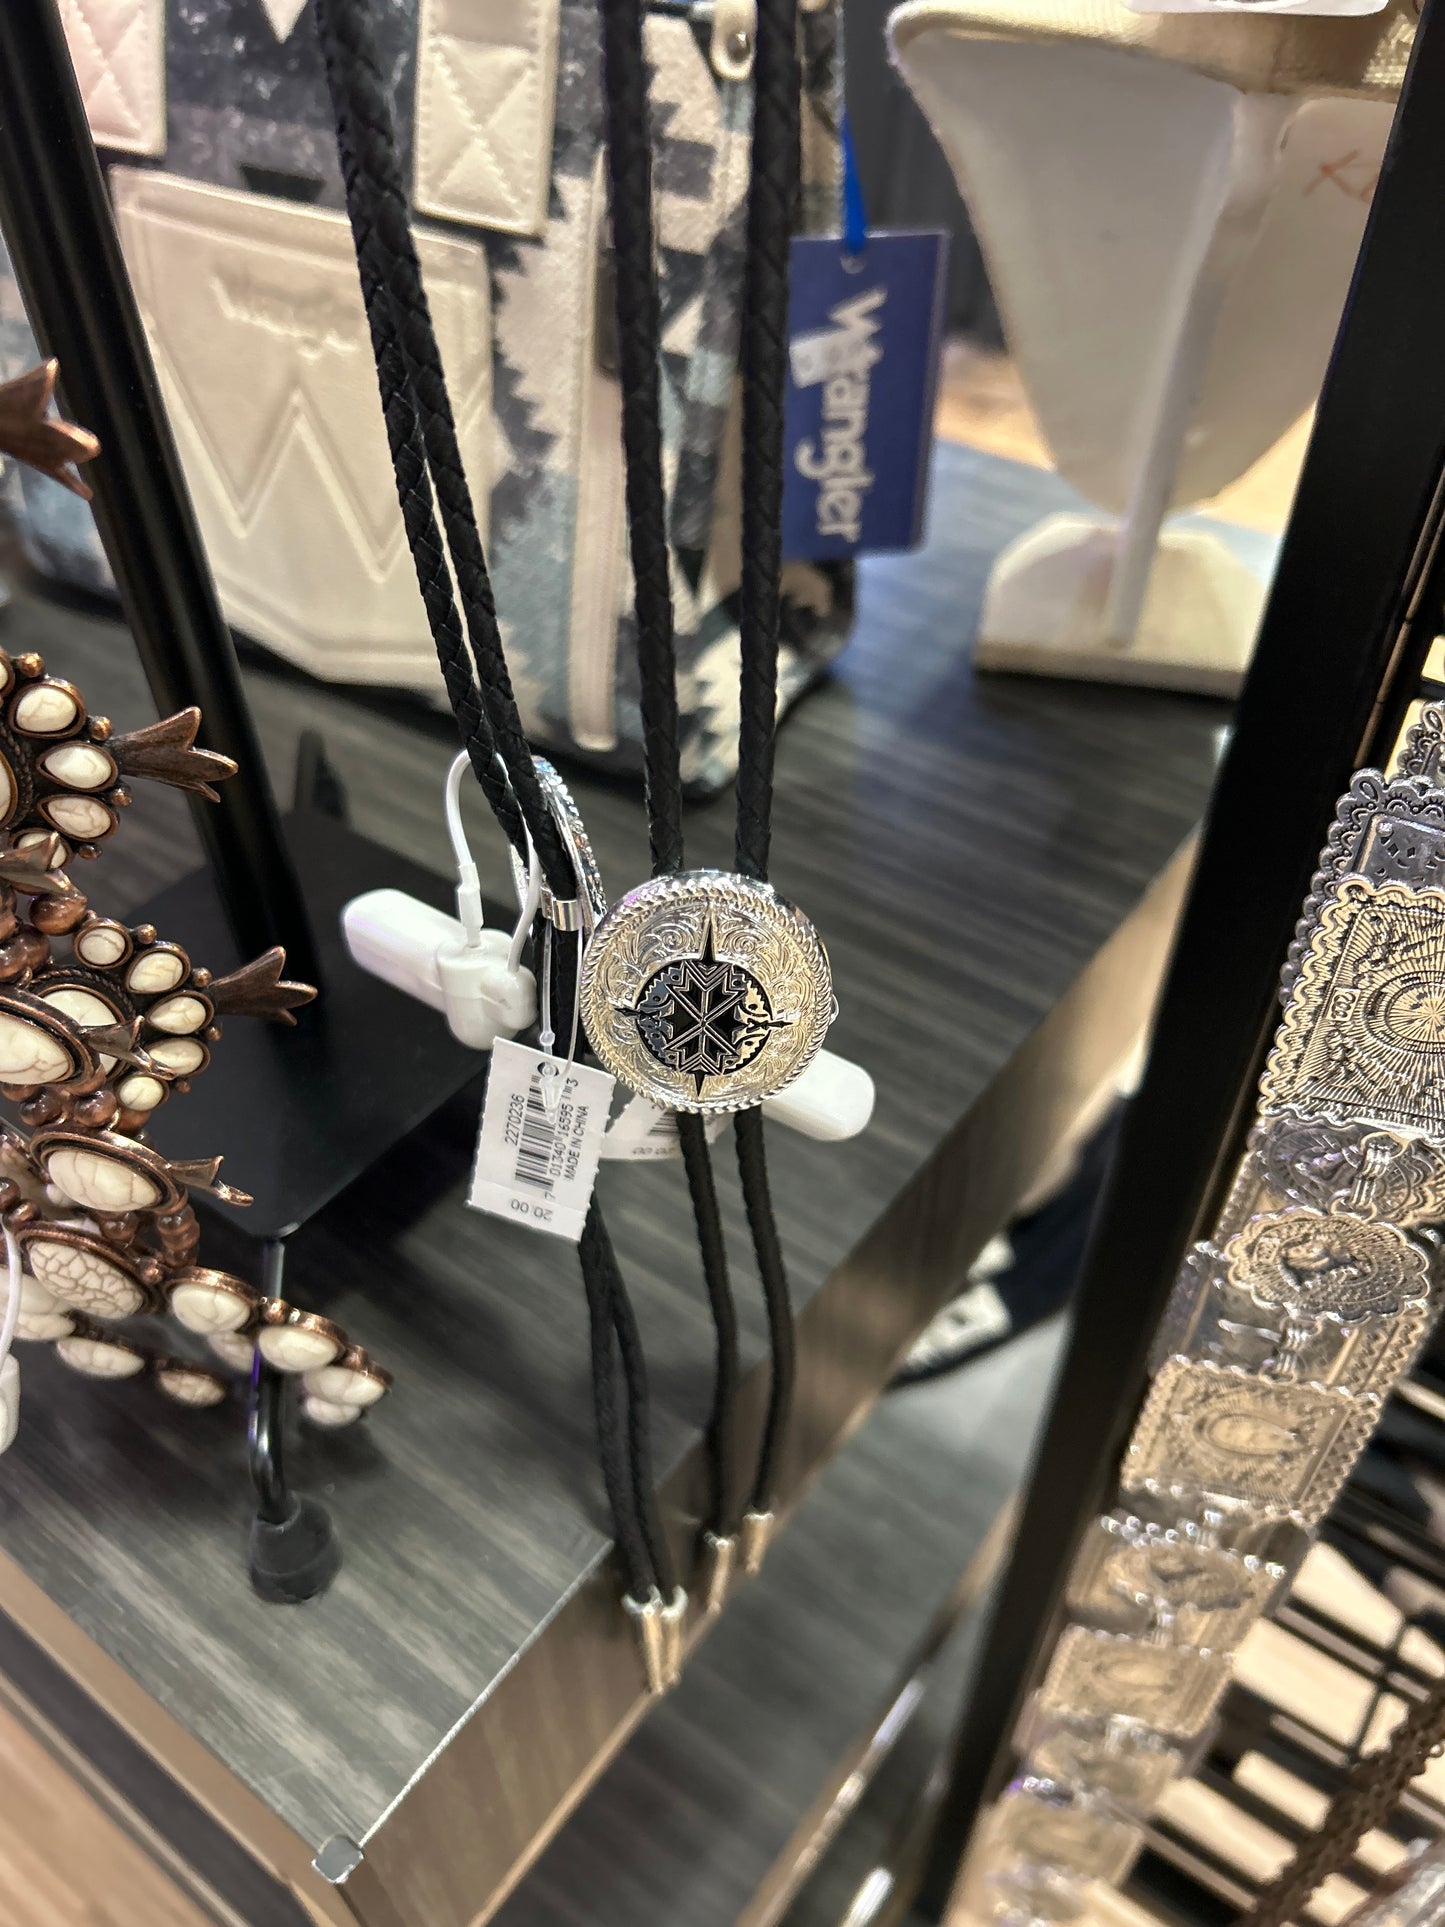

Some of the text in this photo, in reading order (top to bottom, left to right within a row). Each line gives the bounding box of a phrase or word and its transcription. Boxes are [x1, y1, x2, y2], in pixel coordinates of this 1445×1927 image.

[567, 1077, 579, 1087] 3
[504, 1093, 525, 1146] 2270236
[557, 1103, 574, 1138] 16595
[550, 1142, 567, 1177] 01340
[564, 1105, 589, 1181] MADE IN CHINA
